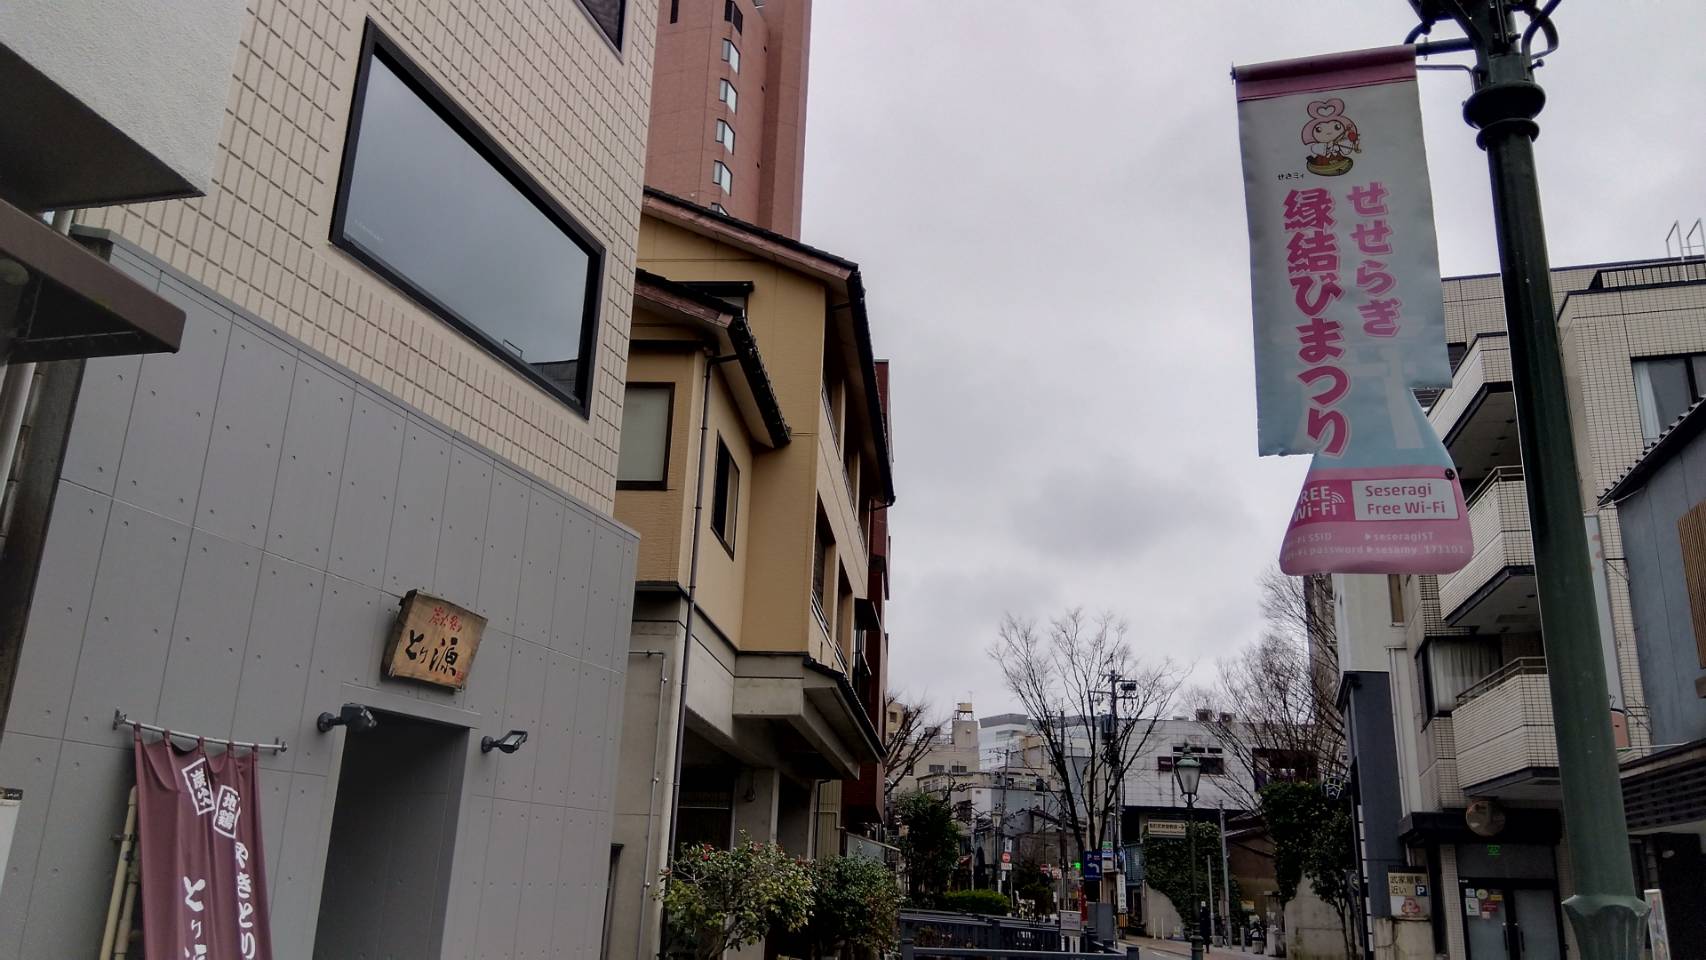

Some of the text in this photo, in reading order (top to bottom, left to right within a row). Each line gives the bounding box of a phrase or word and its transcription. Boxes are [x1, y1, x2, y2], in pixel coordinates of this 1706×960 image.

[1347, 182, 1402, 337] せせらぎ
[1283, 187, 1351, 457] 縁結びまつり
[1300, 486, 1331, 505] REE
[1366, 483, 1432, 499] Seseragi
[1367, 500, 1445, 515] Free Wi-Fi
[1308, 531, 1332, 543] SSID
[1310, 545, 1363, 556] password
[1416, 886, 1425, 895] P
